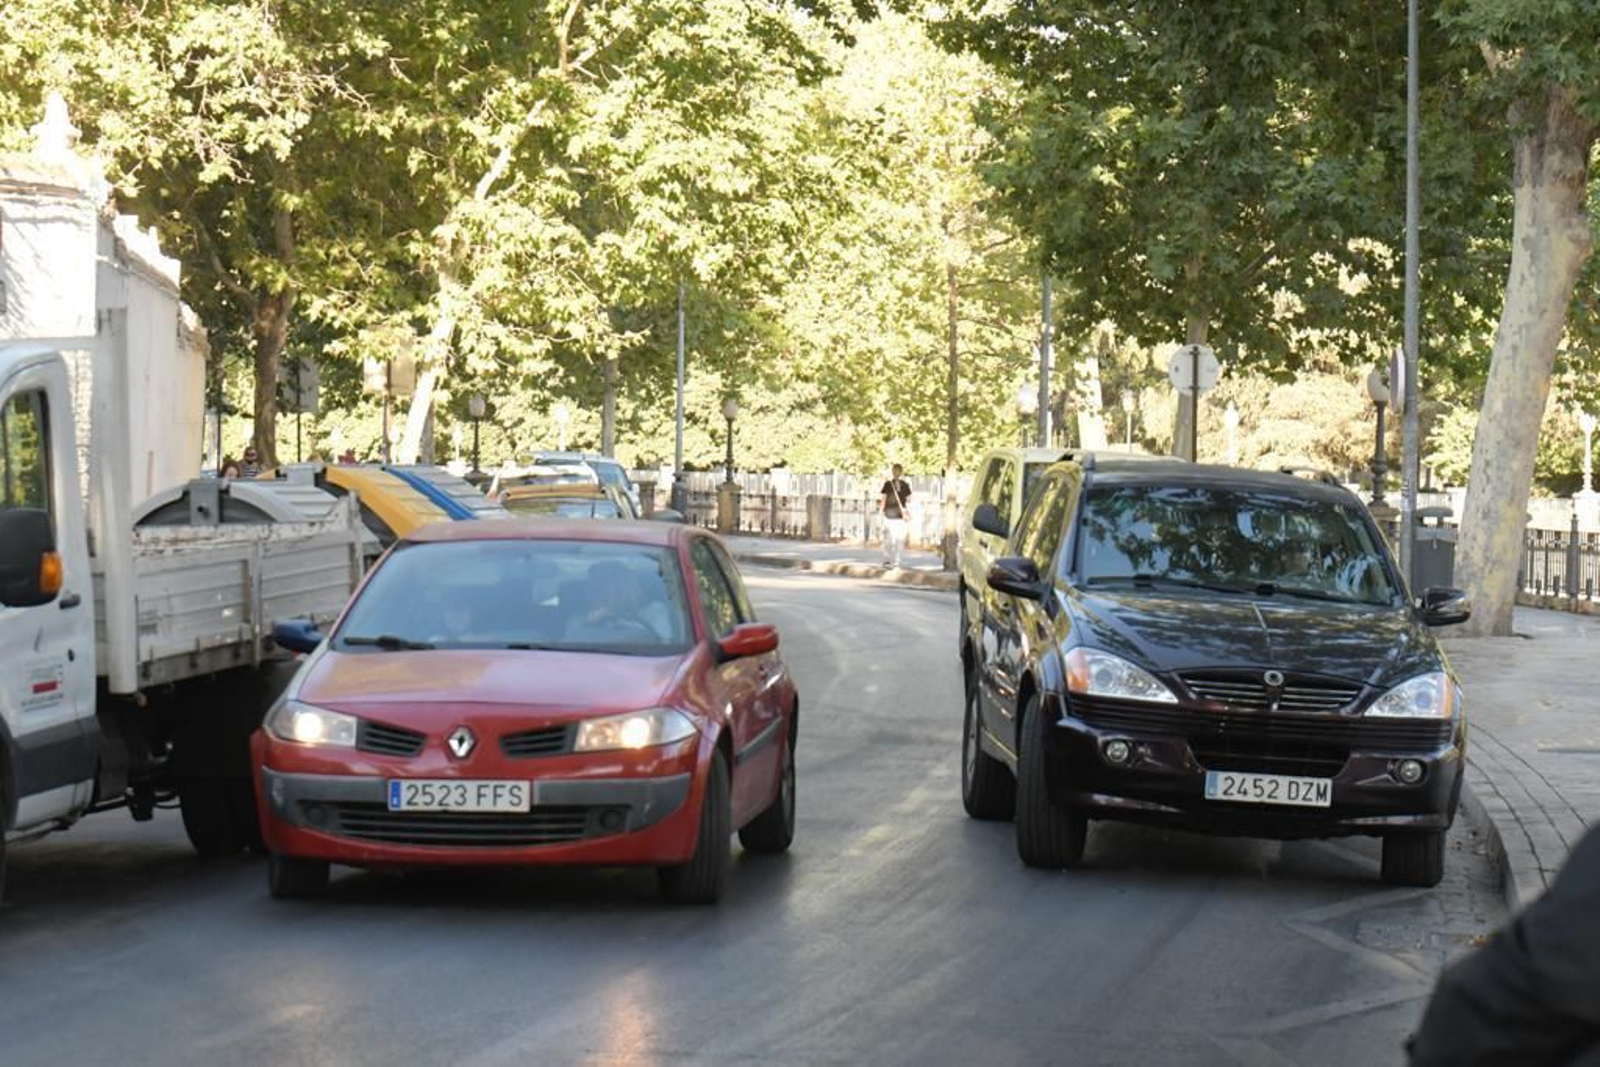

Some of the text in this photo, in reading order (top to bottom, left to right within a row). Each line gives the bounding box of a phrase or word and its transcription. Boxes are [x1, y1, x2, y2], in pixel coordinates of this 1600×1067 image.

[405, 783, 523, 807] 2523 FFS
[1222, 776, 1328, 803] 2452 DZM
